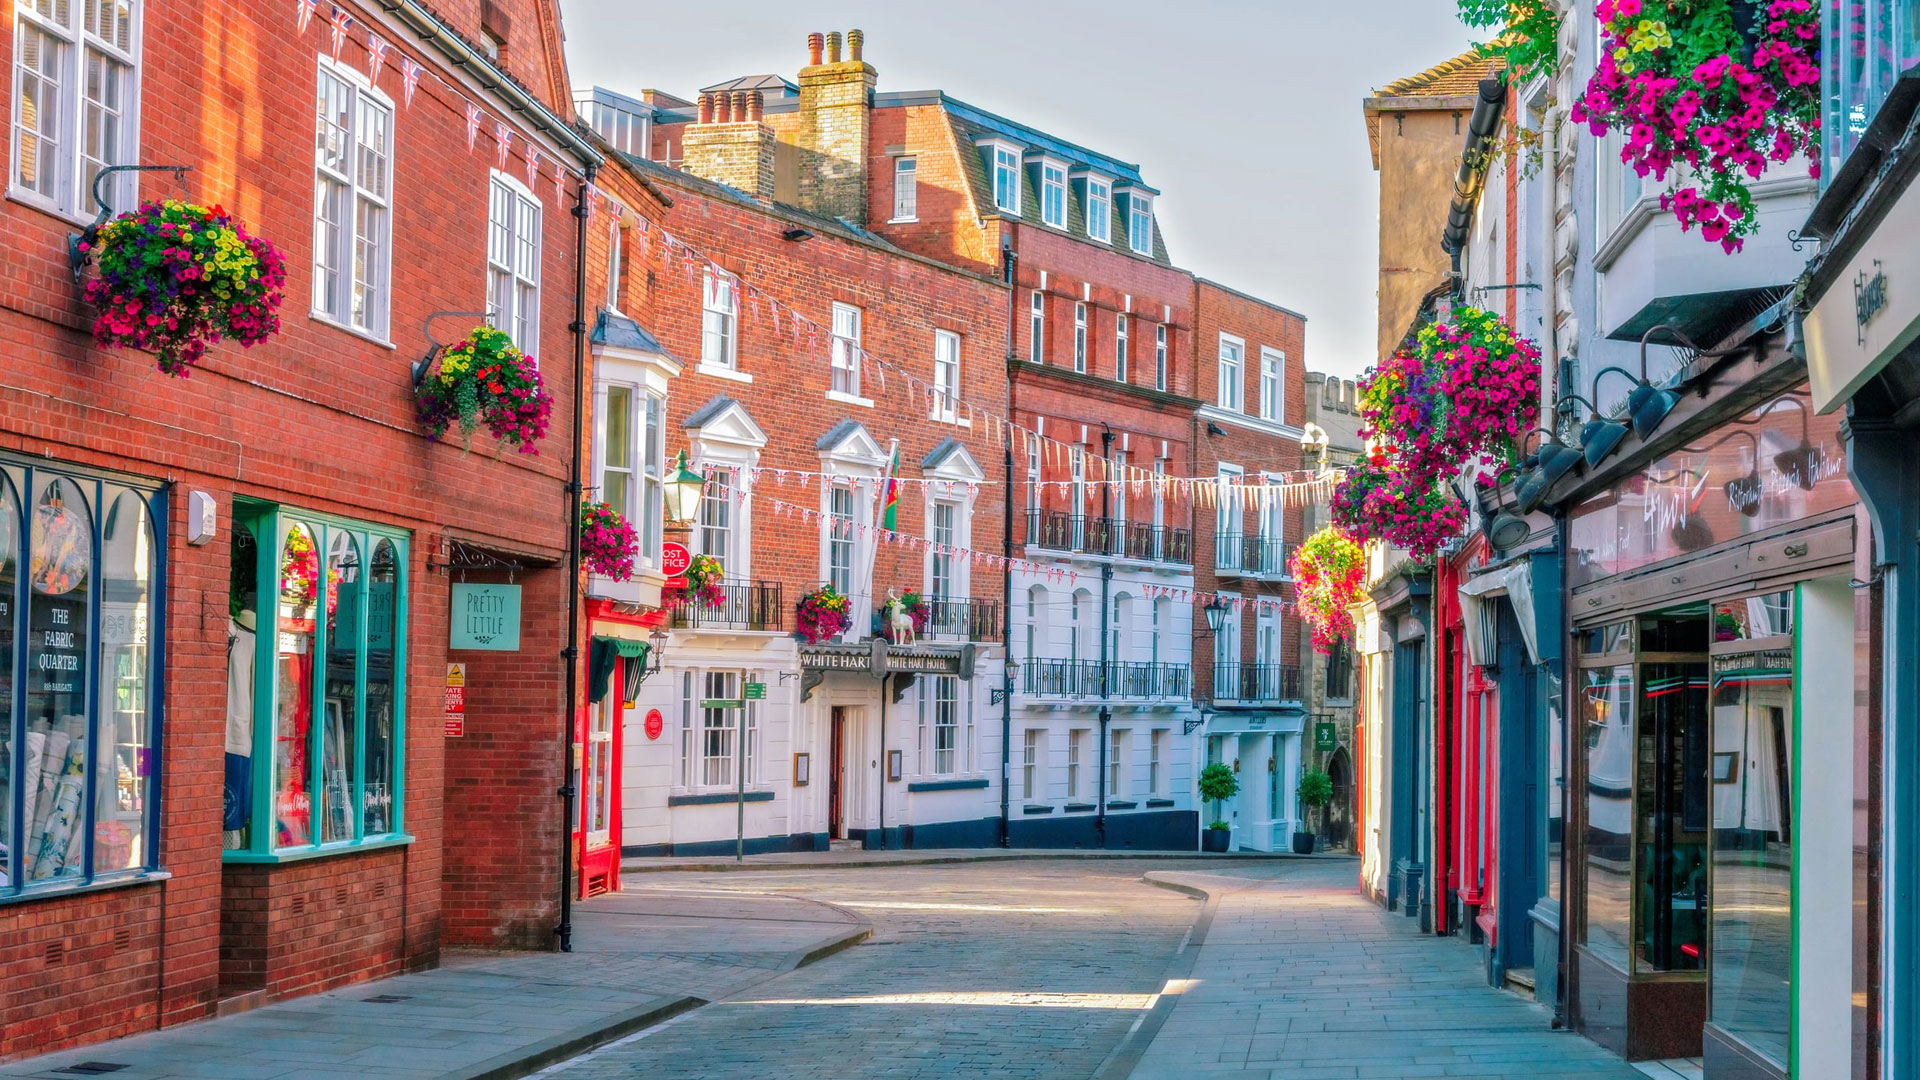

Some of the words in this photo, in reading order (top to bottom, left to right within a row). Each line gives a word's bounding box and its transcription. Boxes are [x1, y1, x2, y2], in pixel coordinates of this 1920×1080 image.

[663, 550, 682, 558] OST
[663, 559, 685, 567] FICE
[0, 603, 8, 615] ry
[467, 593, 504, 613] PRETTY
[52, 608, 69, 624] THE
[466, 614, 503, 634] LITTLE
[44, 631, 74, 648] FABRIC
[39, 653, 78, 671] QUARTER
[802, 655, 838, 667] WHITE
[840, 656, 871, 668] HART
[887, 657, 907, 668] WHITE
[908, 658, 924, 669] HART
[926, 659, 947, 670] HOTEL
